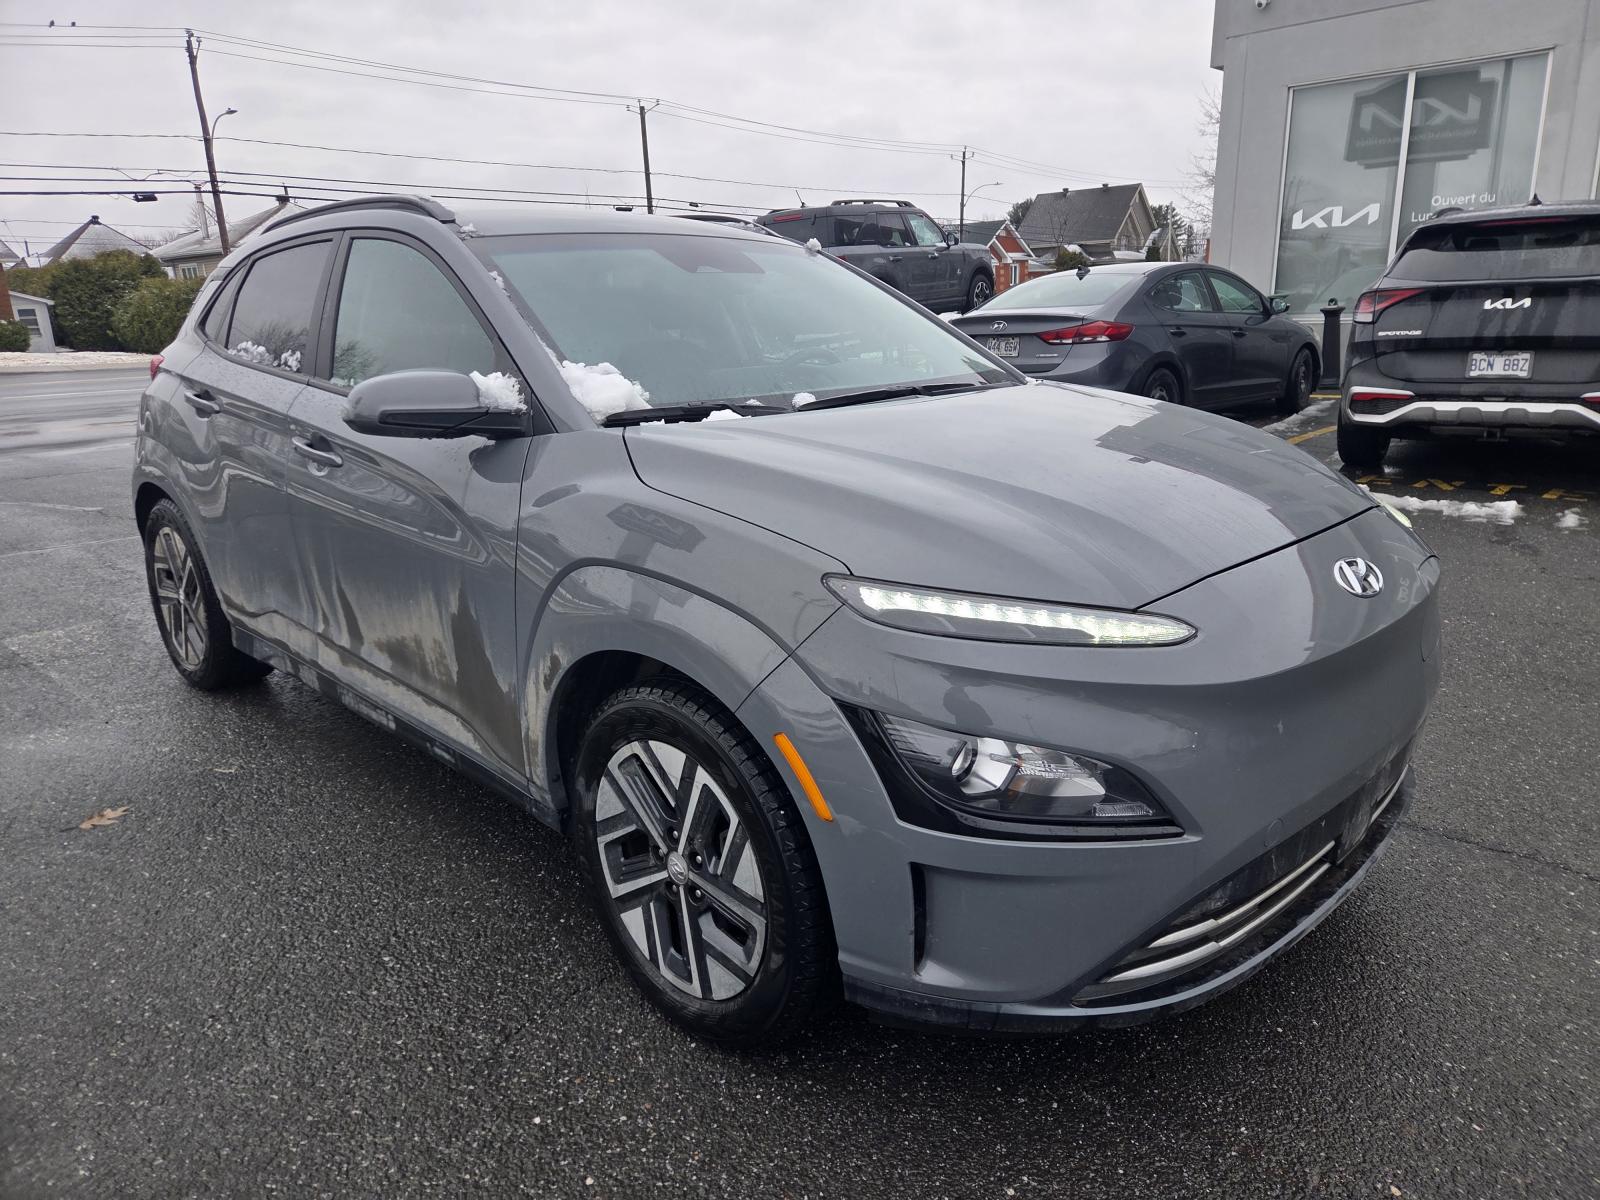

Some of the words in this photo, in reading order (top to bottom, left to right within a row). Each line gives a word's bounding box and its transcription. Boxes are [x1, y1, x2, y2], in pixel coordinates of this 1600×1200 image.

[1431, 193, 1476, 206] Ouvert
[1479, 192, 1496, 203] du
[1503, 358, 1529, 371] 88Z
